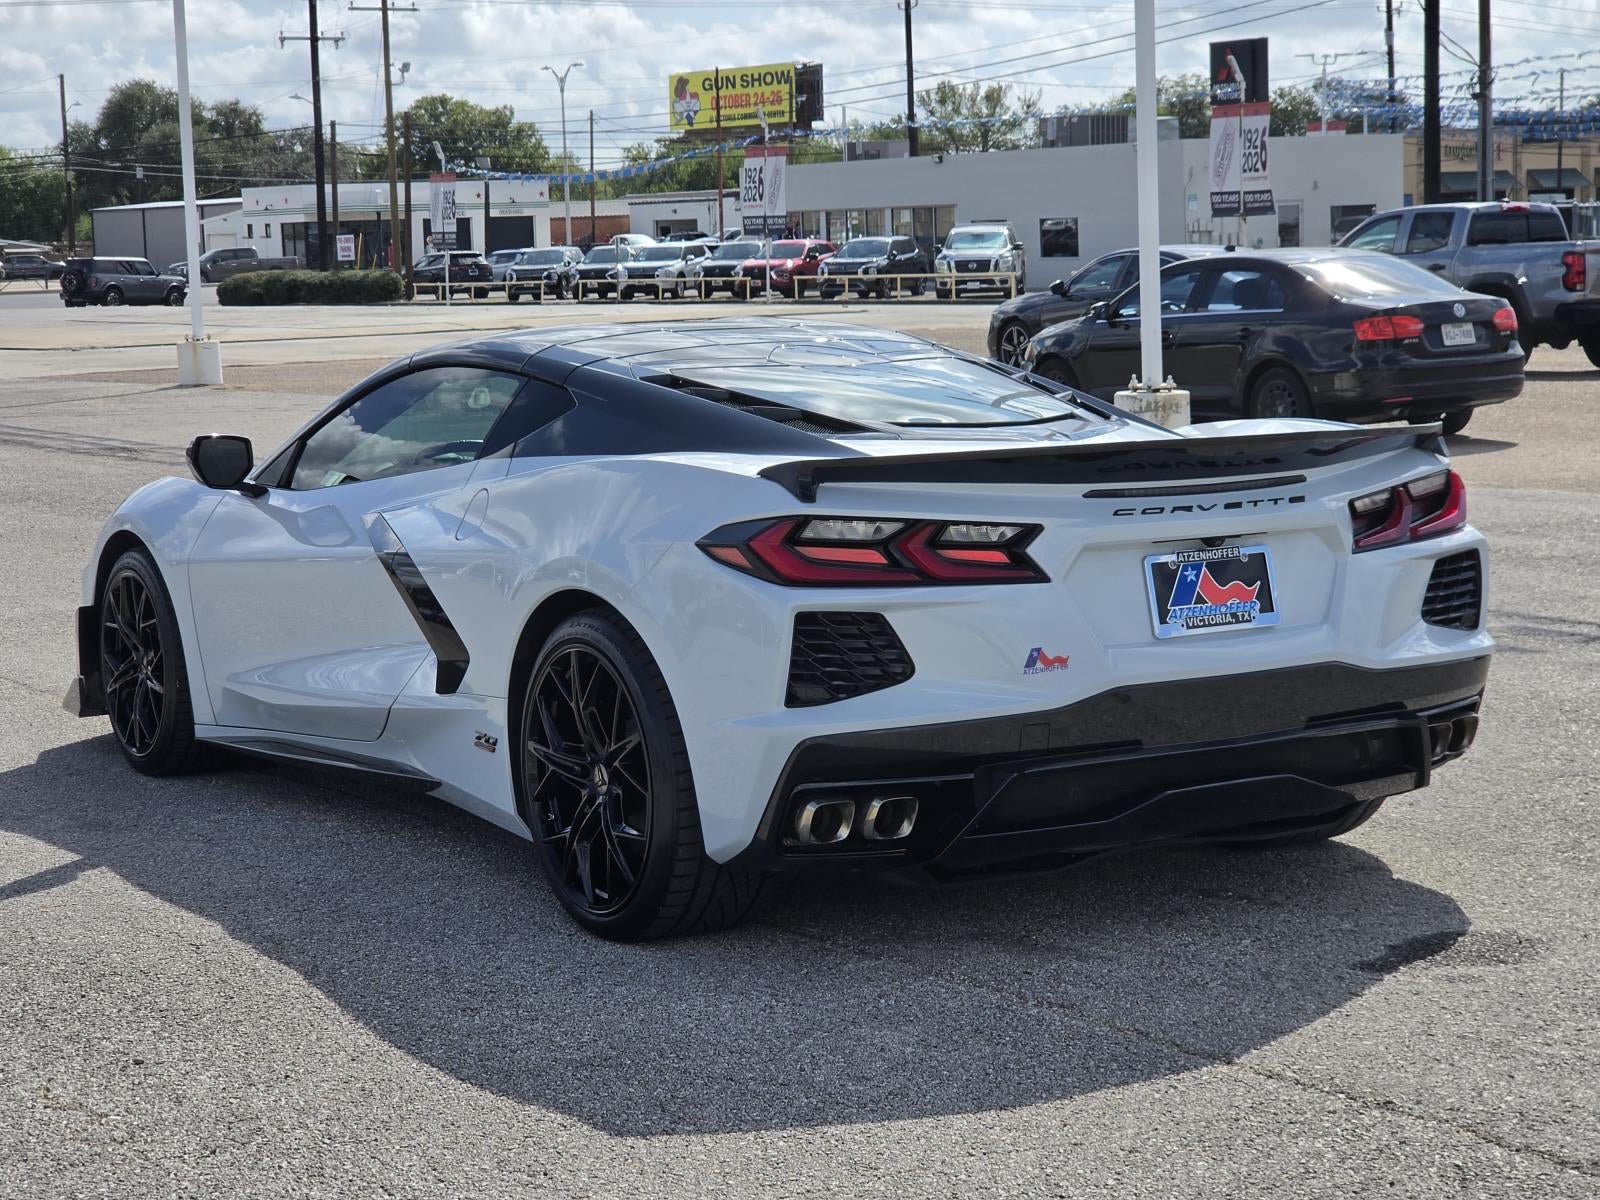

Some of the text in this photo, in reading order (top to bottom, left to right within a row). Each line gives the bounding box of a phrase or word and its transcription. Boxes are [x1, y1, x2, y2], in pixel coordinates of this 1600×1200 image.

[702, 70, 790, 91] GUN SHOW
[1222, 194, 1239, 202] YEARS
[1255, 193, 1271, 201] YEARS
[1112, 495, 1306, 517] CORVETTE
[1178, 547, 1240, 562] ATZENHOFFER
[1168, 601, 1258, 622] ATZENHOFFER
[1187, 611, 1251, 627] VICTORIA, TX
[1023, 664, 1069, 675] ATZENHOFFER
